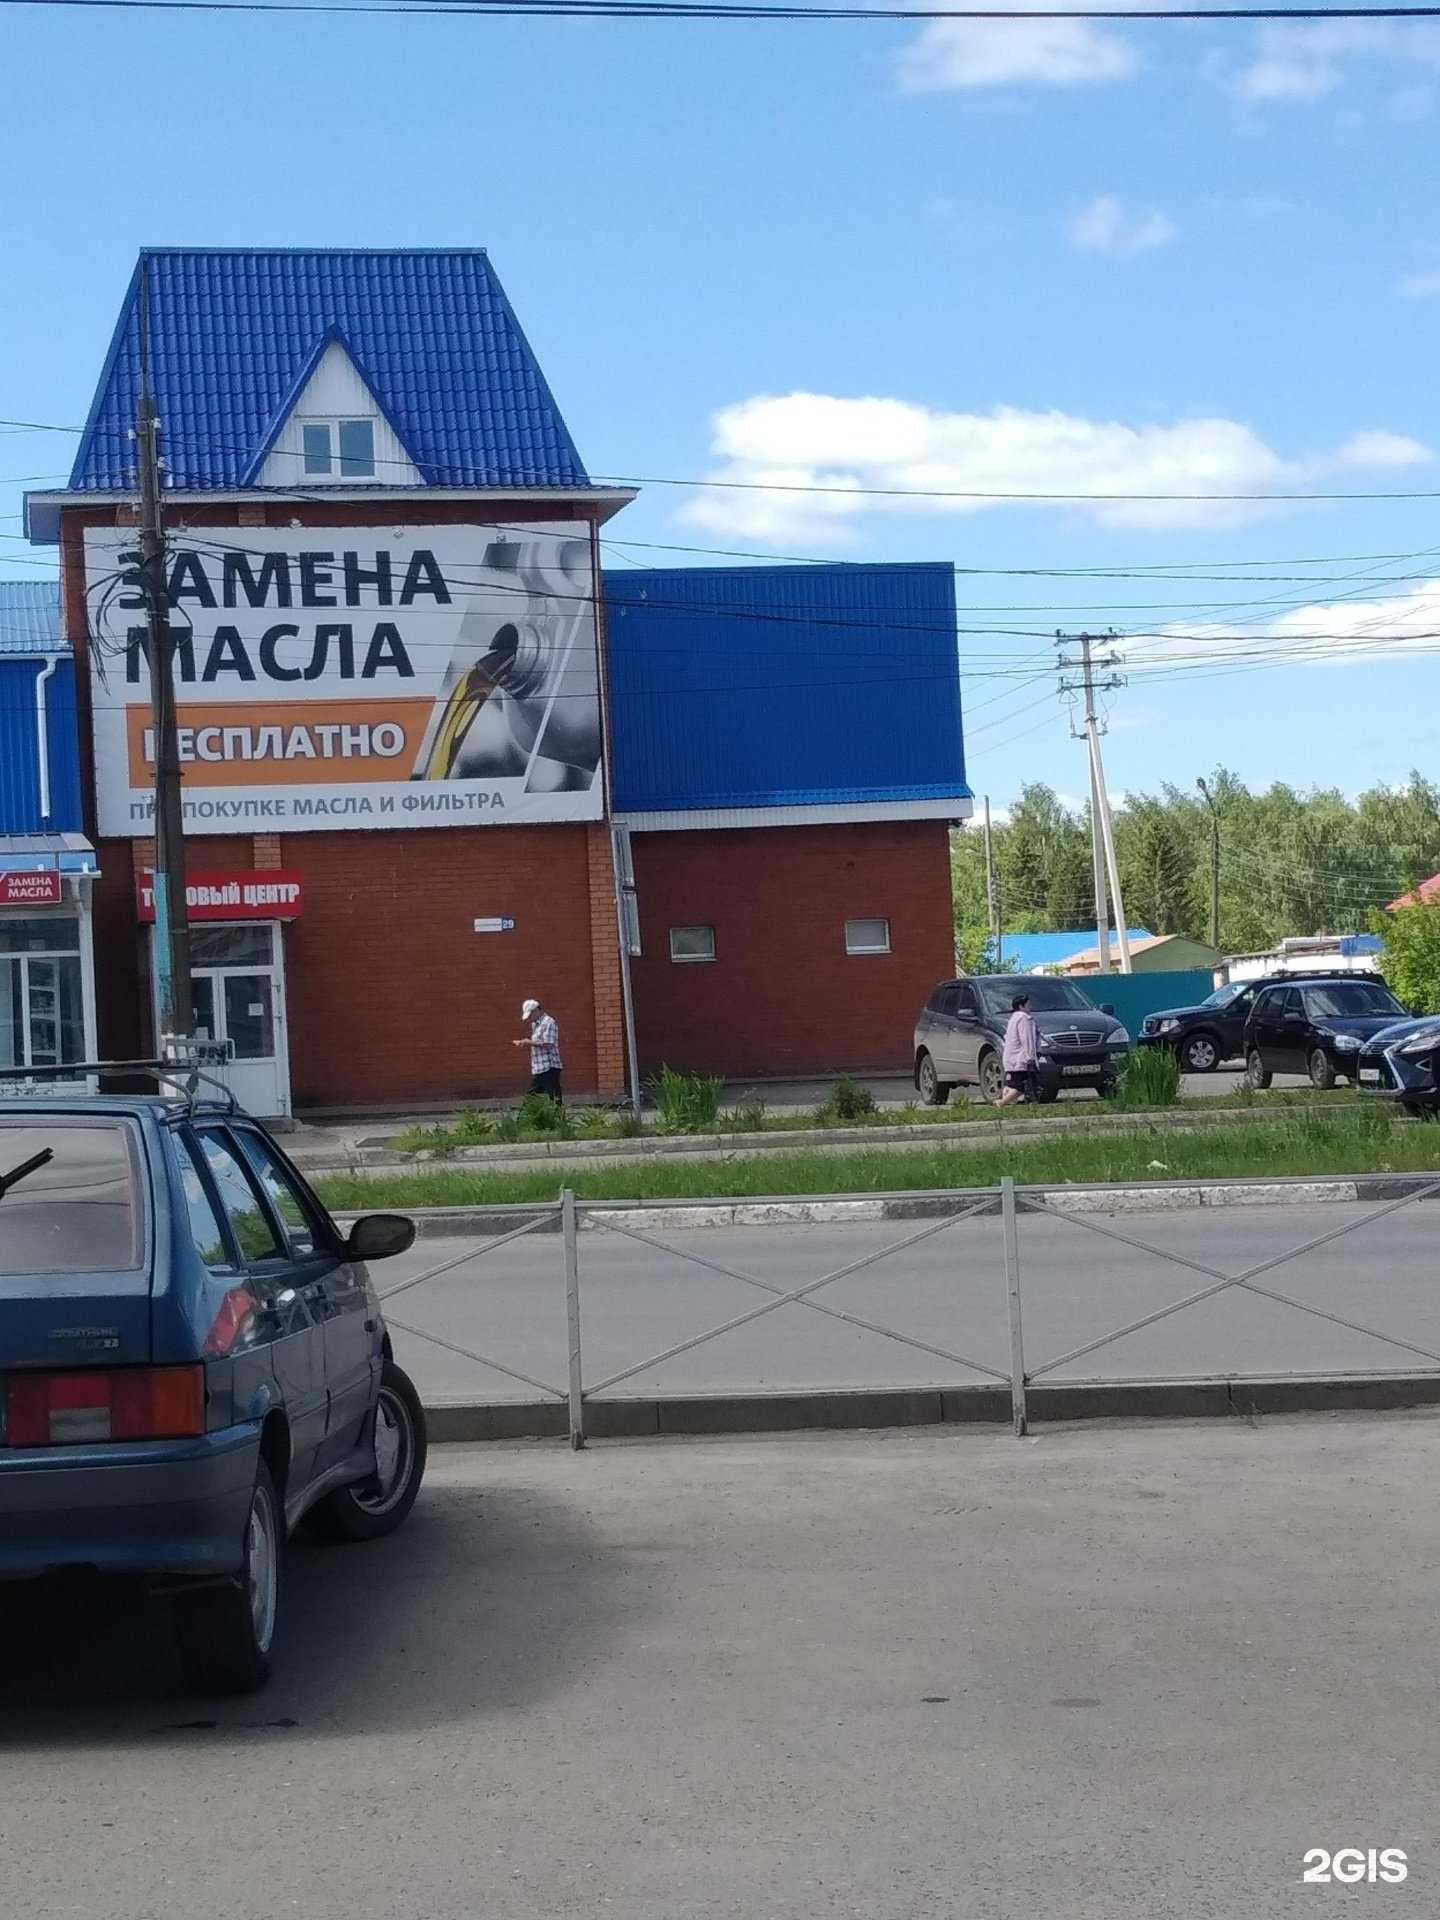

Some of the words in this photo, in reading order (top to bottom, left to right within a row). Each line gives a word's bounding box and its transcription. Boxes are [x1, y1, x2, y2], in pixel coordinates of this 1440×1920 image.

[118, 550, 452, 609] ЗАМЕНА
[127, 621, 415, 683] МАСЛА
[130, 802, 159, 819] ПР
[183, 799, 286, 818] ПОКУПКЕ
[294, 796, 373, 815] МАСЛА
[380, 796, 394, 813] И
[402, 792, 505, 812] ФИЛЬТРА
[8, 876, 52, 887] ЗАМЕНА
[8, 887, 53, 898] МАСЛА
[141, 882, 240, 907] ТОВЫЙ
[243, 883, 300, 906] ЦЕНТР
